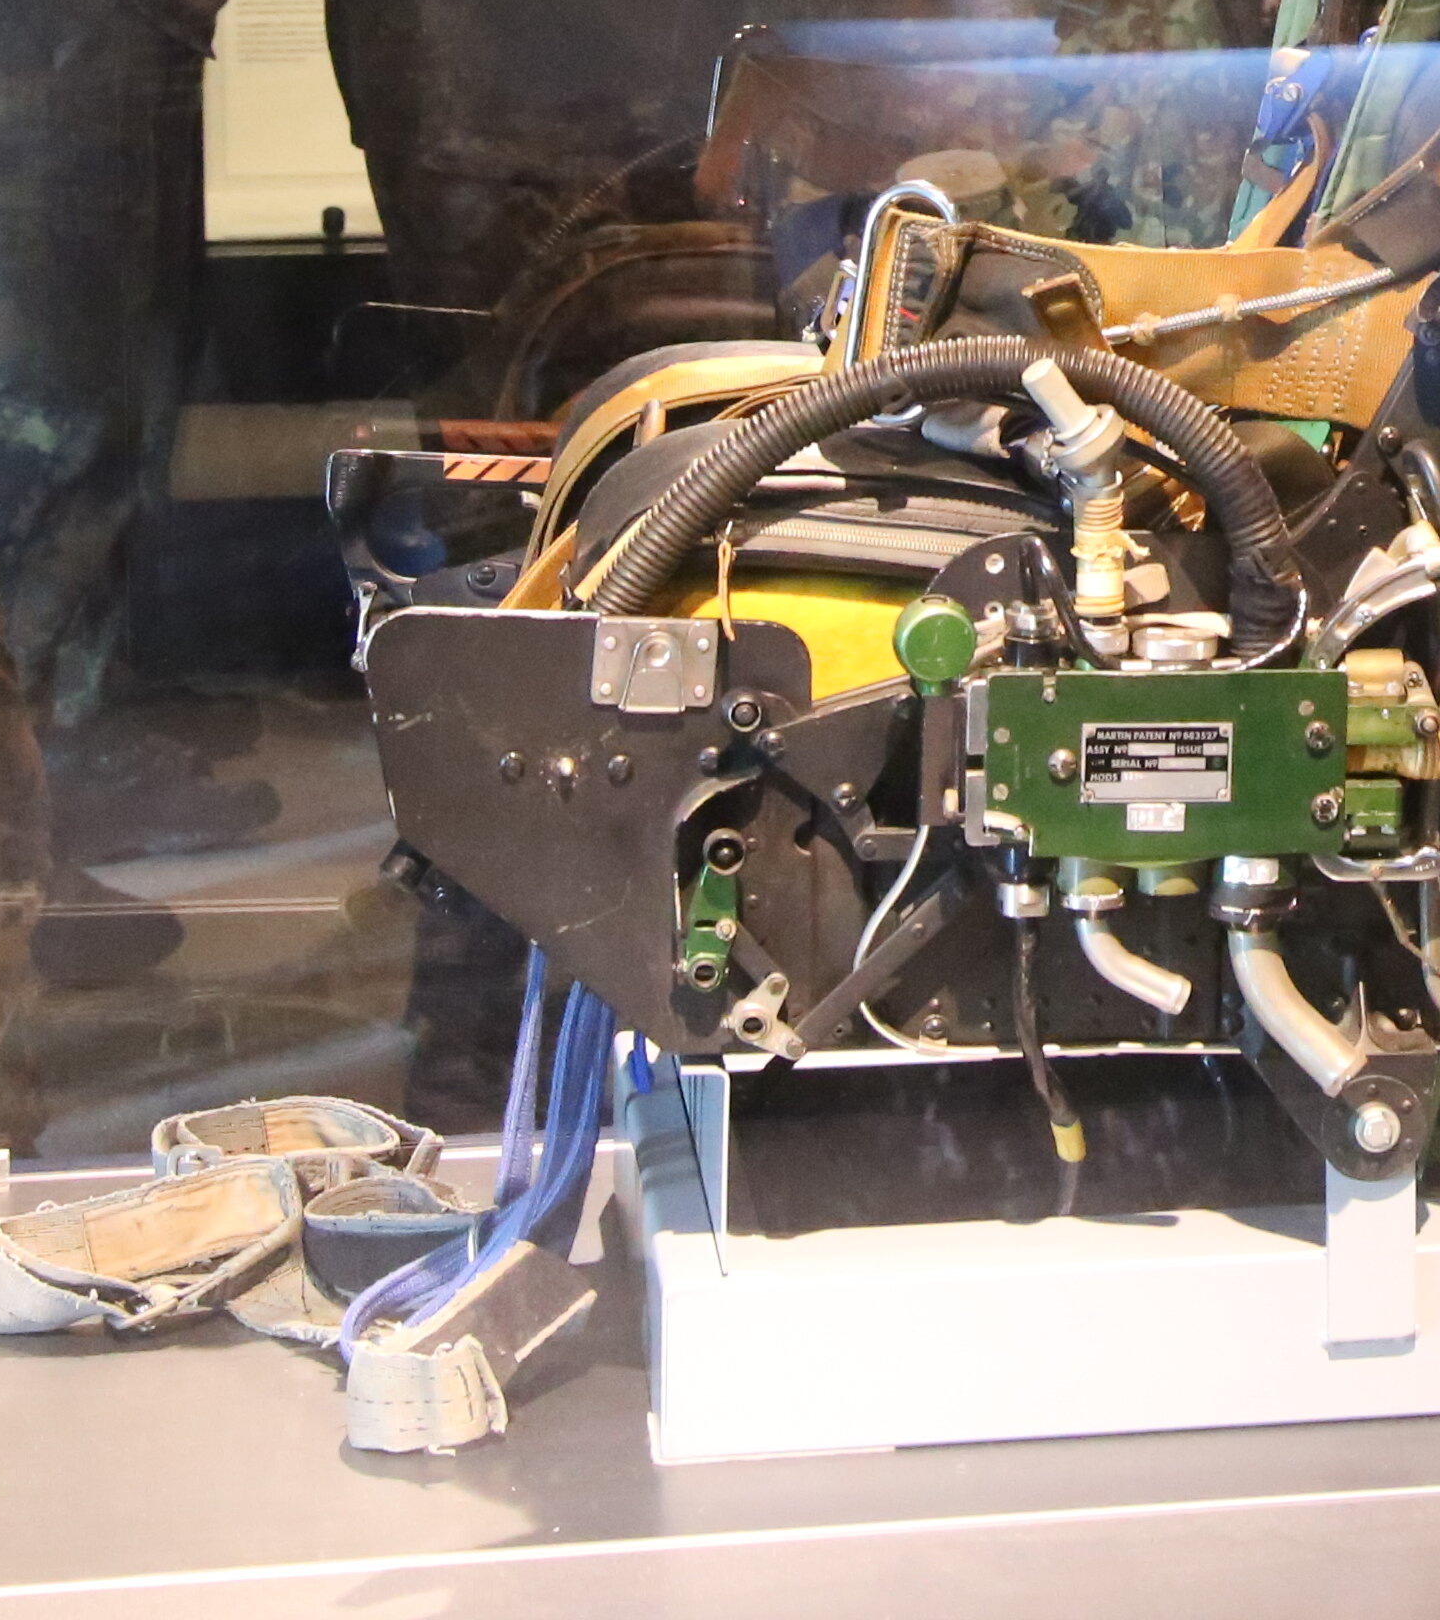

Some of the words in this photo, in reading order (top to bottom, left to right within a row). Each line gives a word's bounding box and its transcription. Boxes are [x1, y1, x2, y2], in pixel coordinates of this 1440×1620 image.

[1096, 731, 1132, 741] MARTIN
[1133, 731, 1167, 741] PATENT
[1086, 745, 1110, 754] ASSY
[1177, 745, 1202, 754] ISSUE
[1111, 759, 1141, 768] SERIAL
[1090, 773, 1118, 782] MODS
